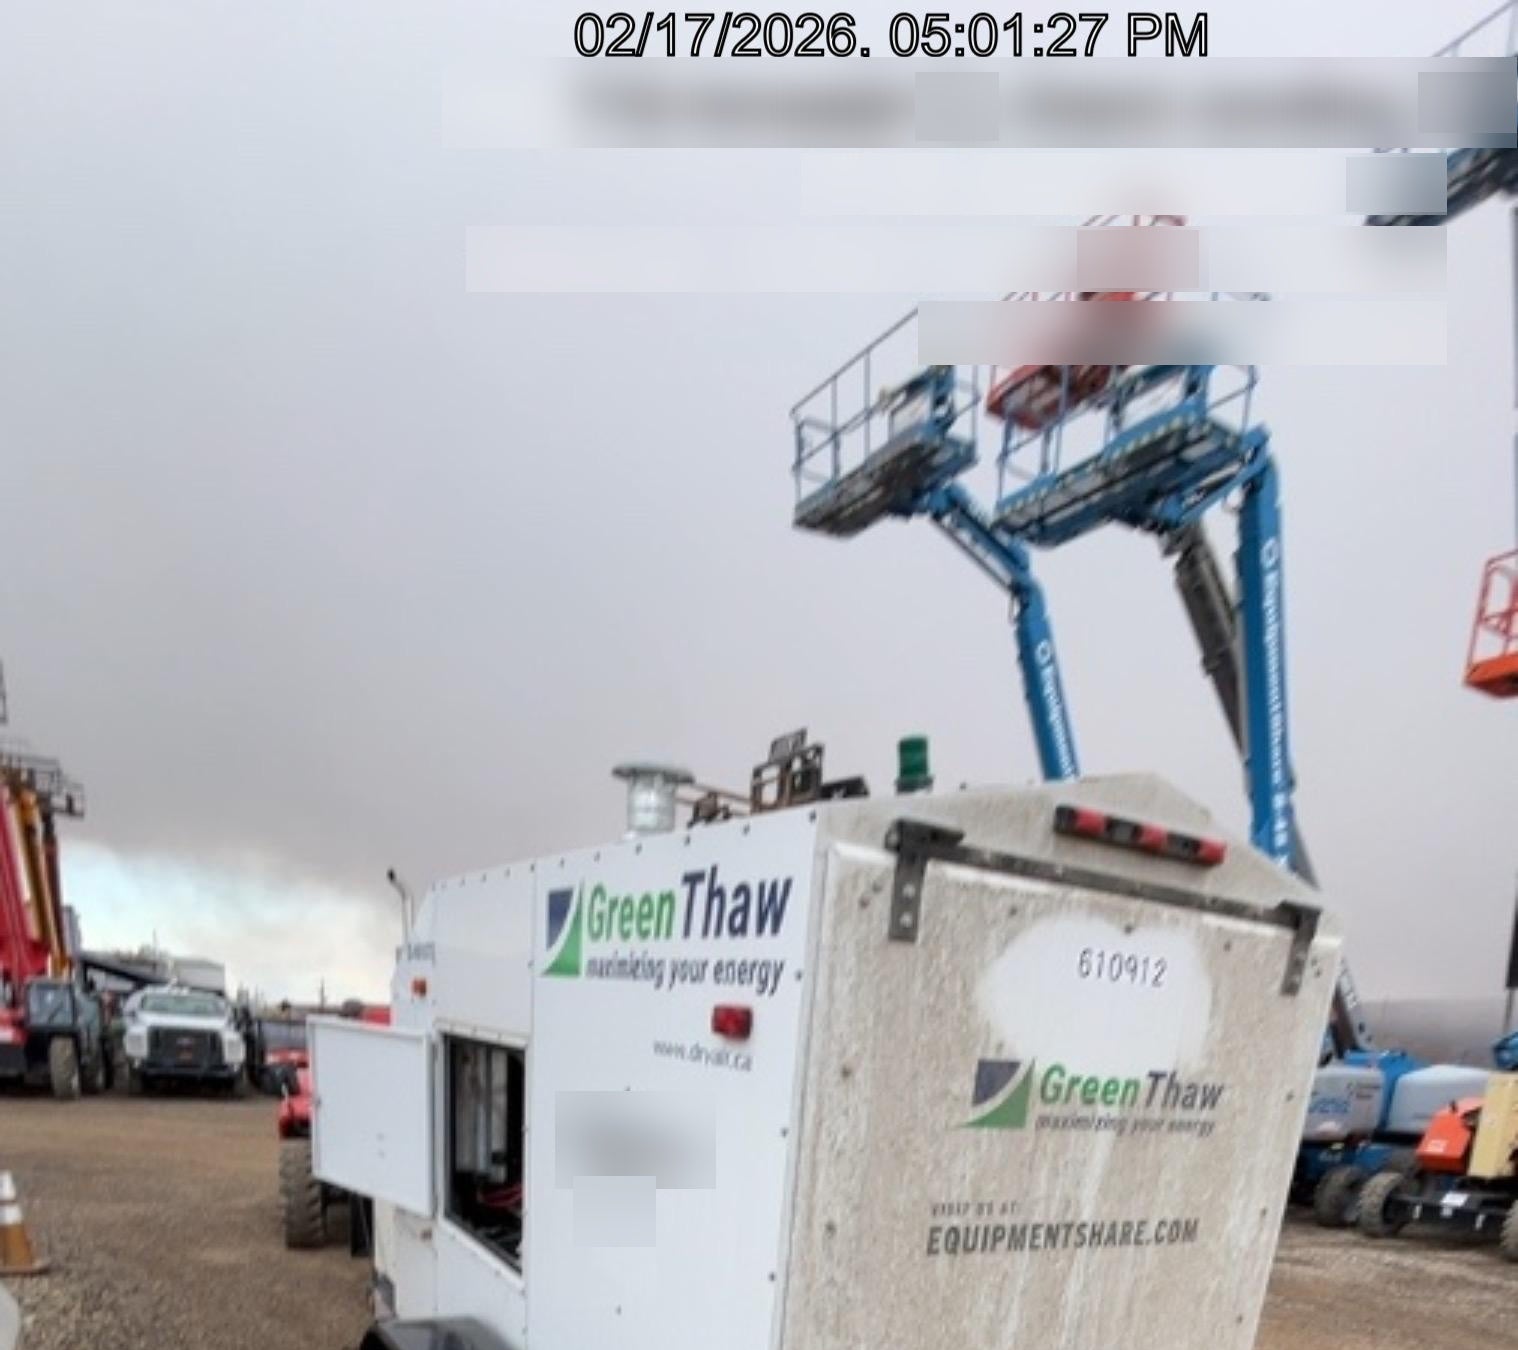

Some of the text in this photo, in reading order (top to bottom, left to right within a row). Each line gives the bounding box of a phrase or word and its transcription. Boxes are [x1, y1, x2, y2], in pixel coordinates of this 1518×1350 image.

[668, 958, 708, 992] your
[713, 958, 785, 997] energy
[1079, 948, 1168, 987] 610912
[926, 1218, 1199, 1256] EQUIPMENTSHARE.COM
